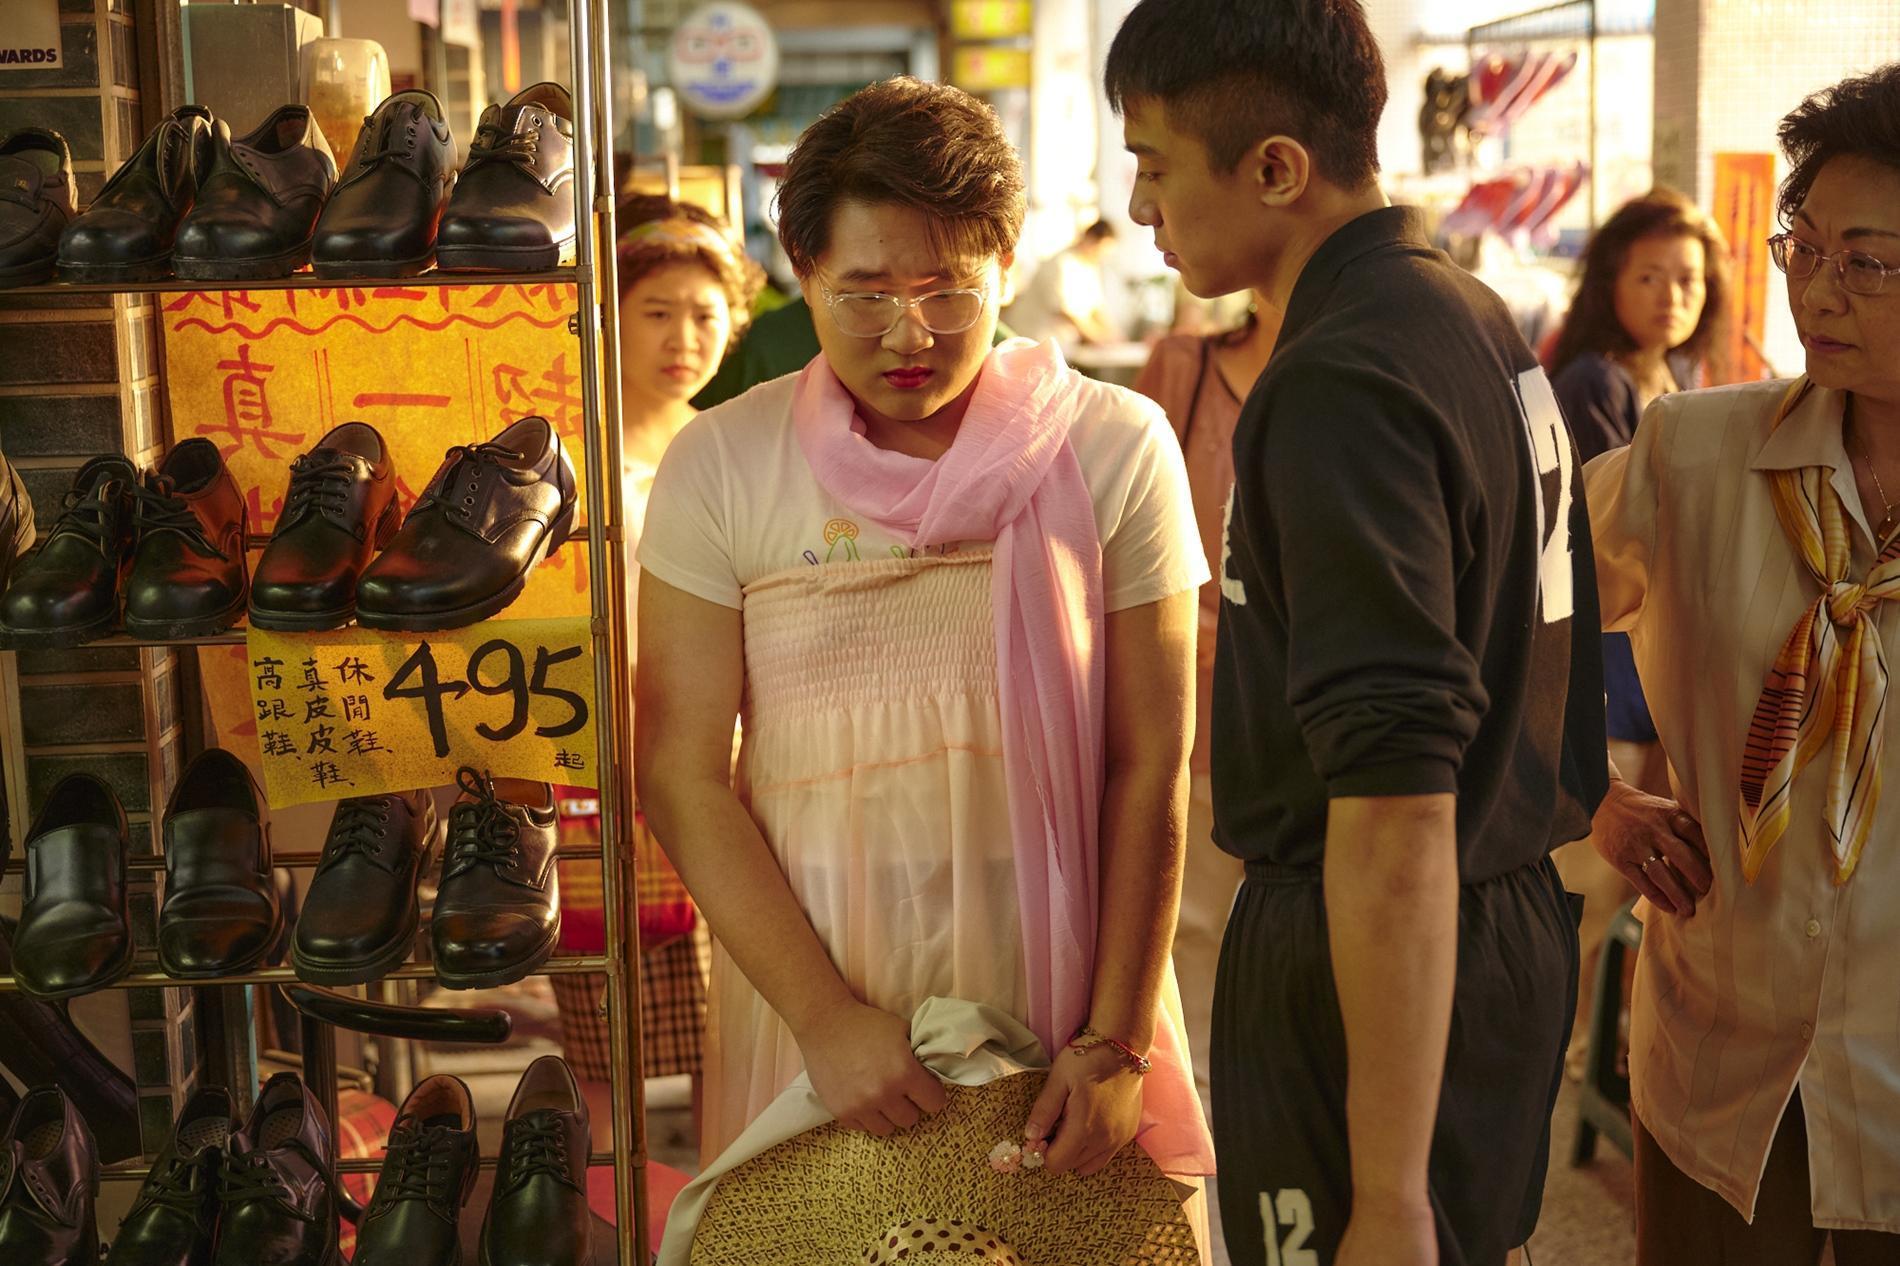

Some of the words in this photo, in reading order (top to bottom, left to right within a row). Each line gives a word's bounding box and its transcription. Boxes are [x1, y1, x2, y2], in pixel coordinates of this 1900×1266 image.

[383, 638, 589, 759] 495
[554, 749, 585, 770] 起
[1259, 1188, 1319, 1266] 12
